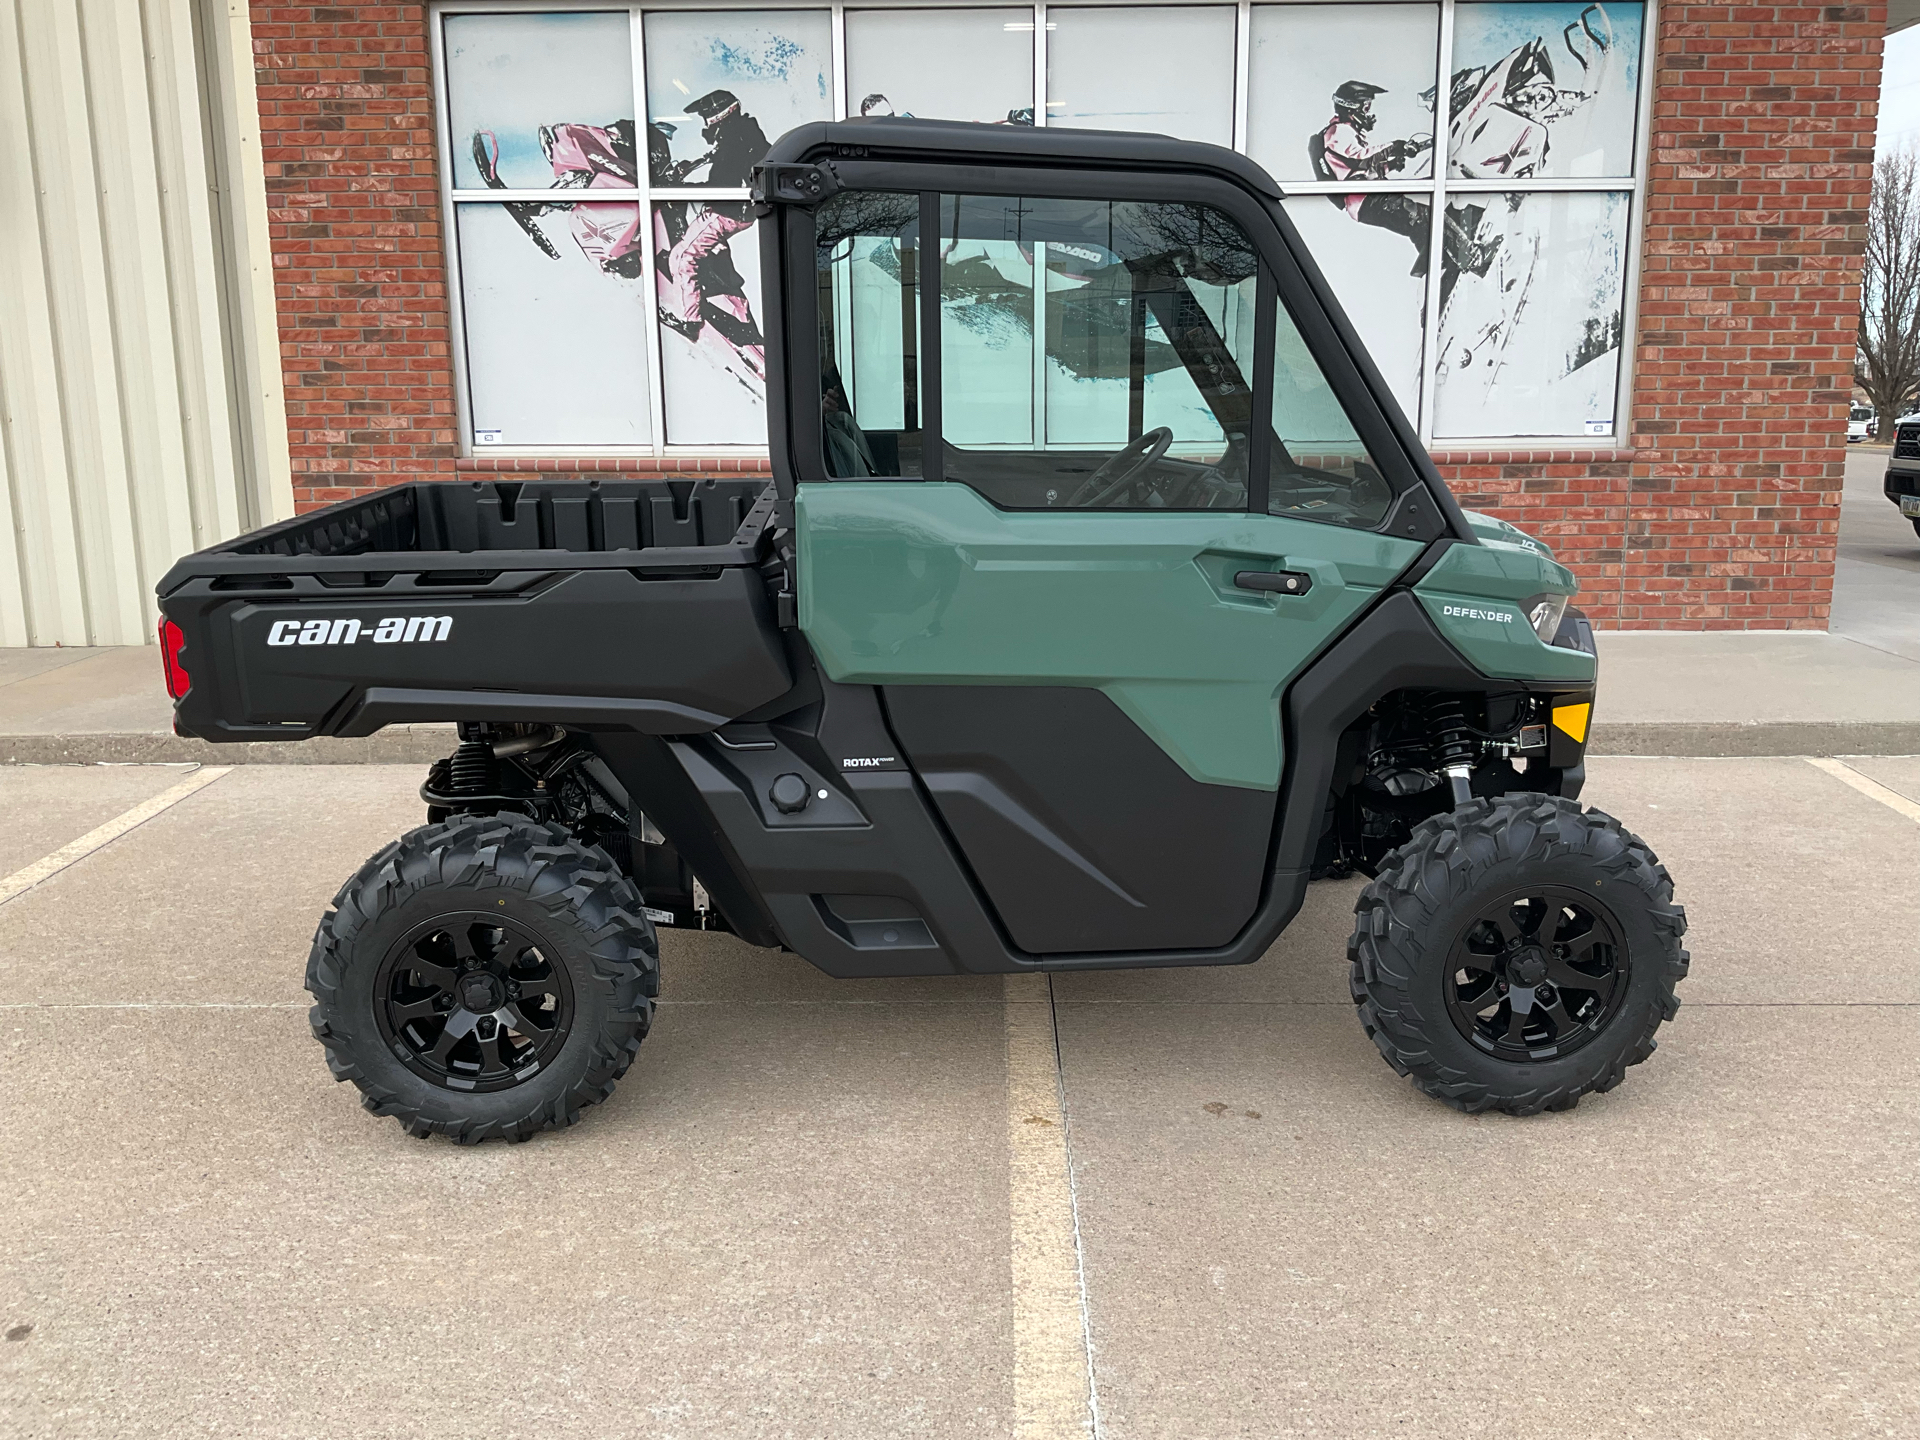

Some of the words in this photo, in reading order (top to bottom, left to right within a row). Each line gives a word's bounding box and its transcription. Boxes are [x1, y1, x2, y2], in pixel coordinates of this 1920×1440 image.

[1443, 605, 1513, 624] DEFENDER
[267, 616, 453, 646] can-am
[843, 758, 880, 767] ROTAX
